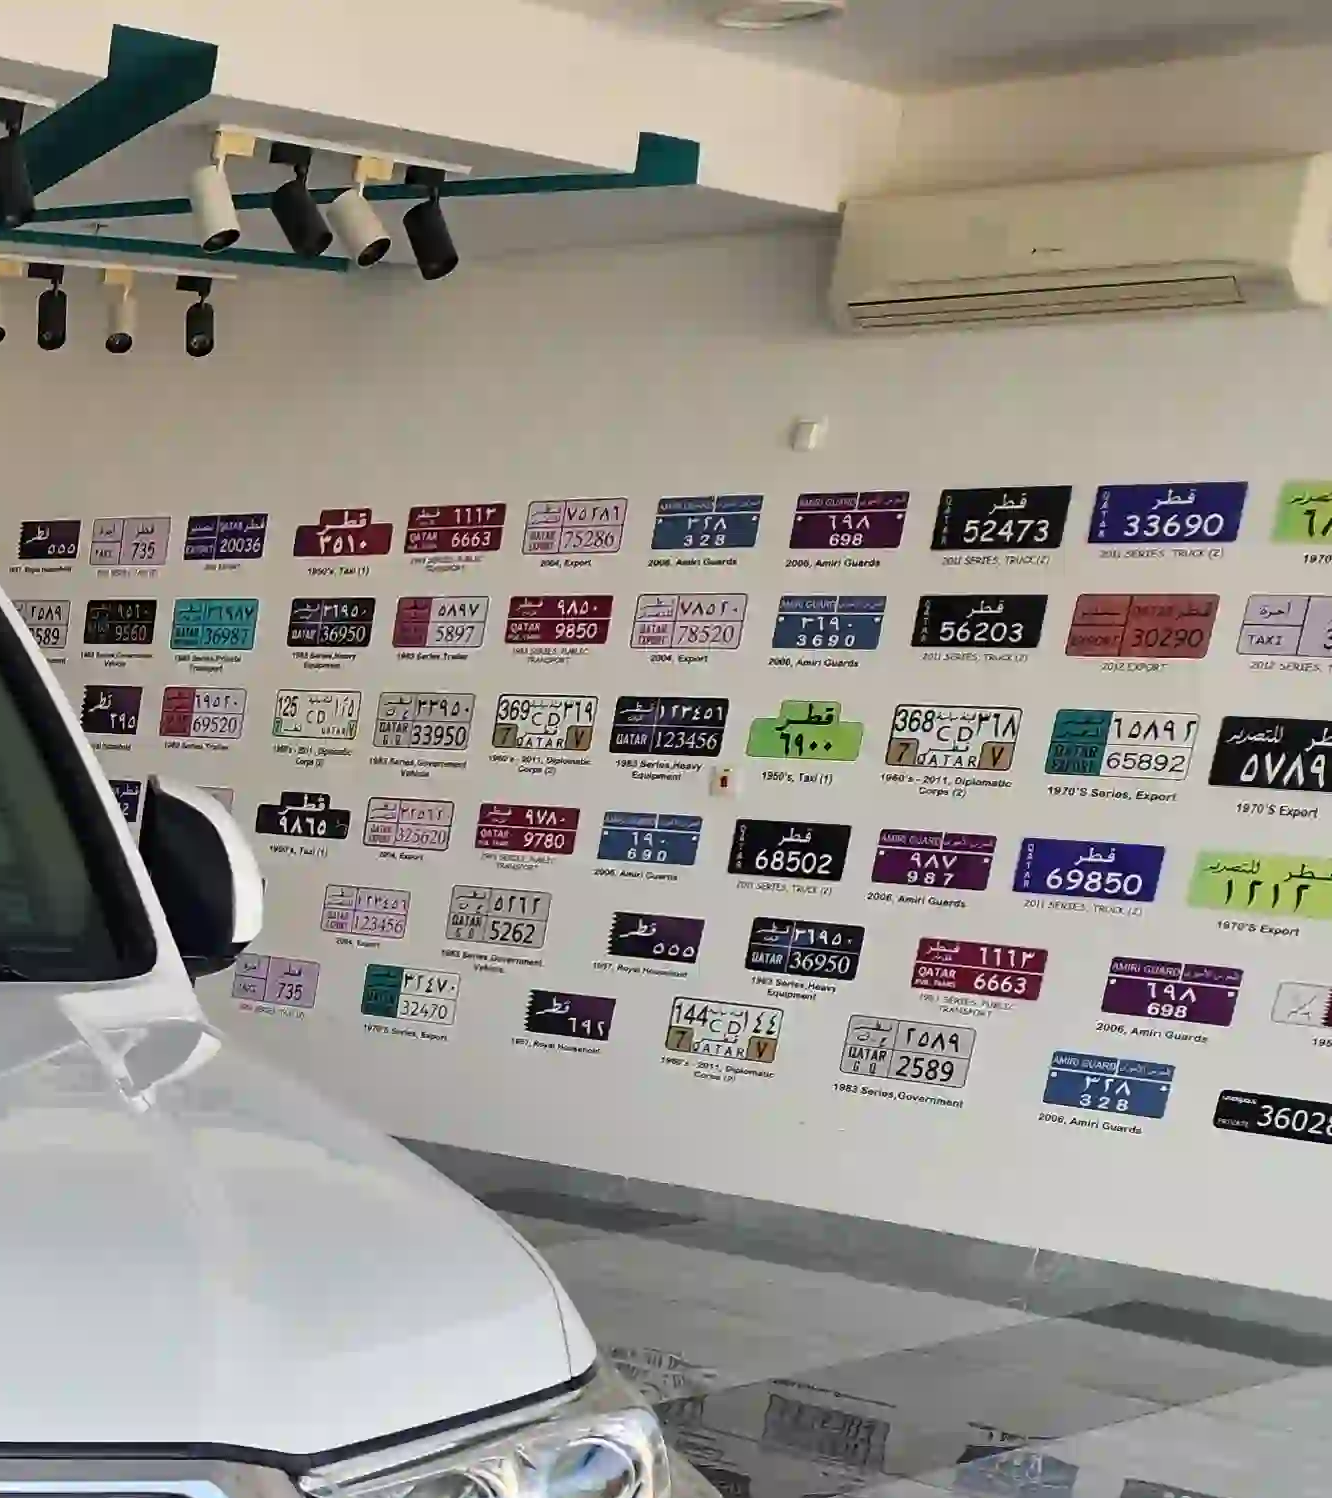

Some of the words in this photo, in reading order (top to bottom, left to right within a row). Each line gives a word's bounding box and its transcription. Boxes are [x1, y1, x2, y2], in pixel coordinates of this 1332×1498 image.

[989, 492, 1027, 515] قطر
[1152, 489, 1197, 510] قطر
[963, 518, 1050, 544] 52473
[1123, 513, 1224, 538] 33690
[219, 537, 261, 553] 20036
[451, 531, 491, 547] 6663
[563, 530, 614, 548] 75286
[829, 533, 864, 546] 698
[844, 558, 880, 568] Guards
[965, 601, 1004, 618] قطر
[320, 625, 366, 643] 36950
[436, 627, 474, 644] 5897
[554, 623, 598, 639] 9850
[677, 625, 734, 645] 78520
[939, 622, 1024, 643] 56203
[1248, 634, 1282, 646] TAXI
[498, 700, 530, 720] 369
[193, 717, 237, 733] 69520
[894, 708, 937, 733] 368
[411, 725, 466, 746] 33950
[616, 732, 648, 746] QATAR
[654, 732, 718, 749] 123456
[1105, 751, 1186, 773] 65892
[799, 772, 817, 782] Taxi
[955, 777, 1013, 790] Diplomatic
[1135, 790, 1177, 803] Export
[1279, 804, 1319, 819] Export
[523, 831, 565, 849] 9780
[778, 828, 813, 847] قطر
[755, 850, 833, 874] 68502
[1073, 847, 1116, 866] قطر
[1045, 867, 1143, 897] 69850
[927, 896, 967, 909] Guards
[353, 915, 404, 935] 123456
[489, 921, 536, 943] 5262
[1259, 924, 1300, 937] Export
[788, 951, 851, 975] 36950
[1112, 961, 1142, 974] AMIRI
[1144, 963, 1181, 977] GUARD
[917, 966, 957, 979] QATAR
[276, 982, 303, 1000] 735
[973, 974, 1028, 994] 6663
[400, 1000, 449, 1020] 32470
[674, 1003, 709, 1025] 144
[1146, 1001, 1189, 1019] 698
[1096, 1022, 1127, 1035] 2006,
[1131, 1026, 1162, 1039] Amiri
[1164, 1030, 1209, 1044] Guards
[847, 1046, 888, 1063] QATAR
[895, 1055, 955, 1083] 2589
[1039, 1113, 1067, 1124] 2006,
[1069, 1117, 1099, 1128] Amiri
[1102, 1121, 1142, 1136] Guards
